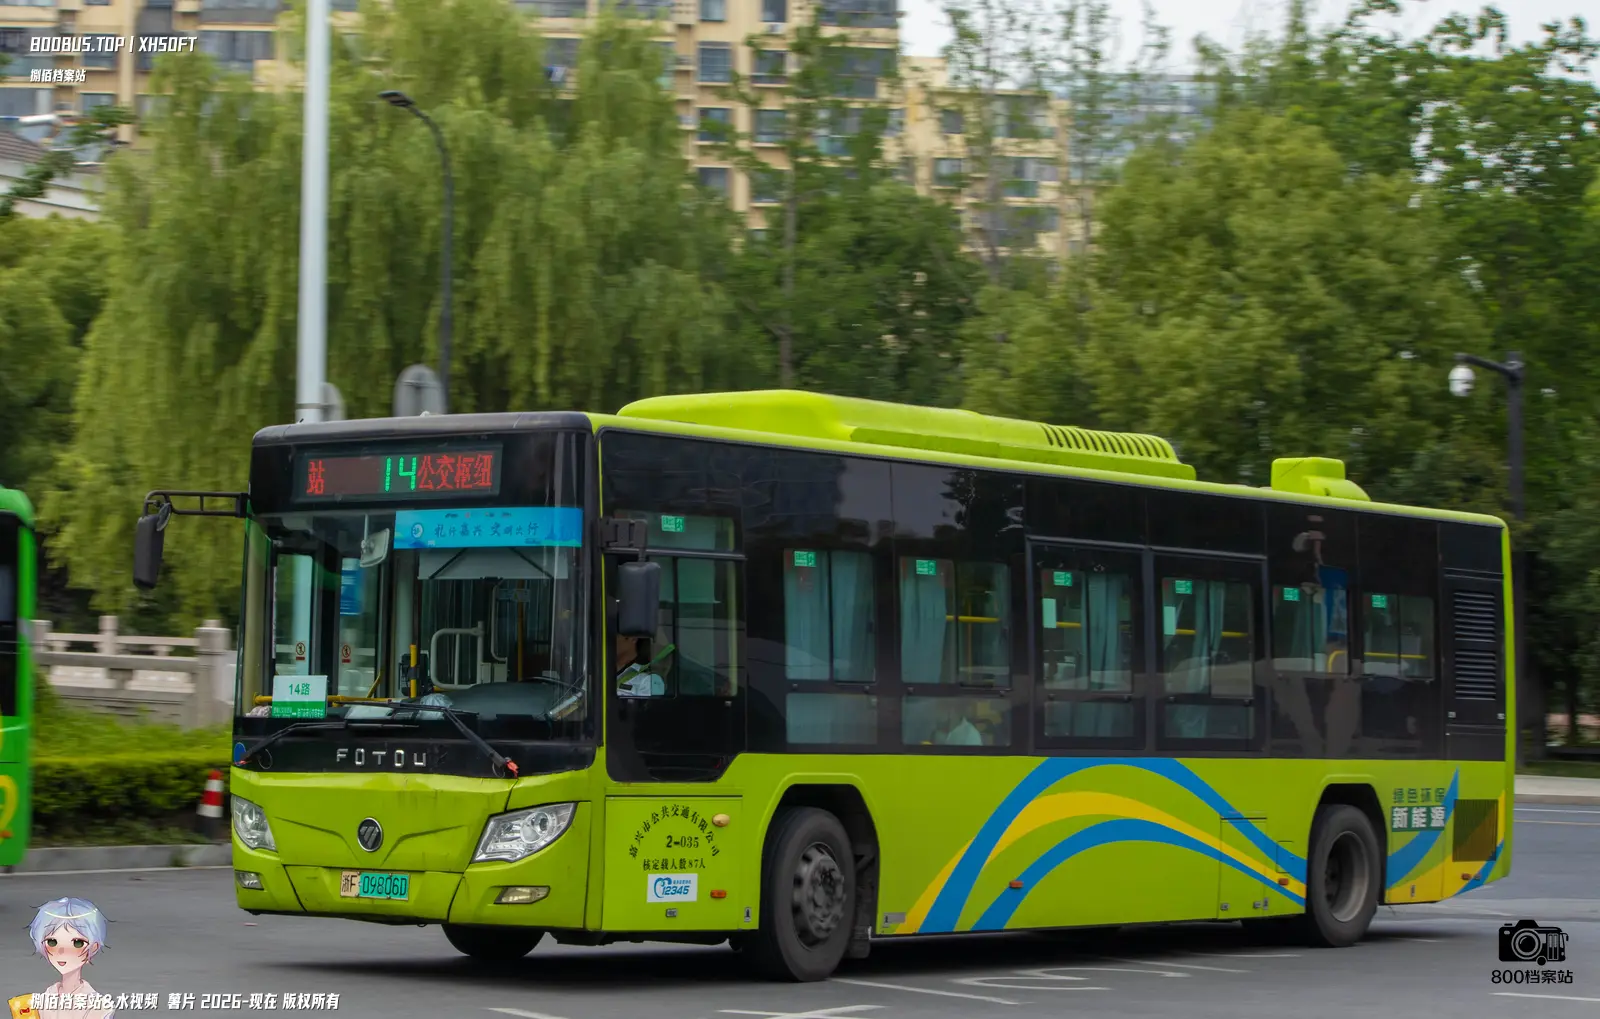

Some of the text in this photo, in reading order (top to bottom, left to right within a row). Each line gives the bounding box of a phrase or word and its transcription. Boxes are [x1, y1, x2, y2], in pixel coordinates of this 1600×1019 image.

[306, 454, 493, 495] 站 14 公交枢纽
[288, 682, 311, 696] 14路
[629, 804, 720, 859] 嘉兴市公共交通有限公司
[666, 835, 700, 848] 2-035
[643, 858, 706, 871] 核定载人数87人
[662, 885, 691, 896] 12345
